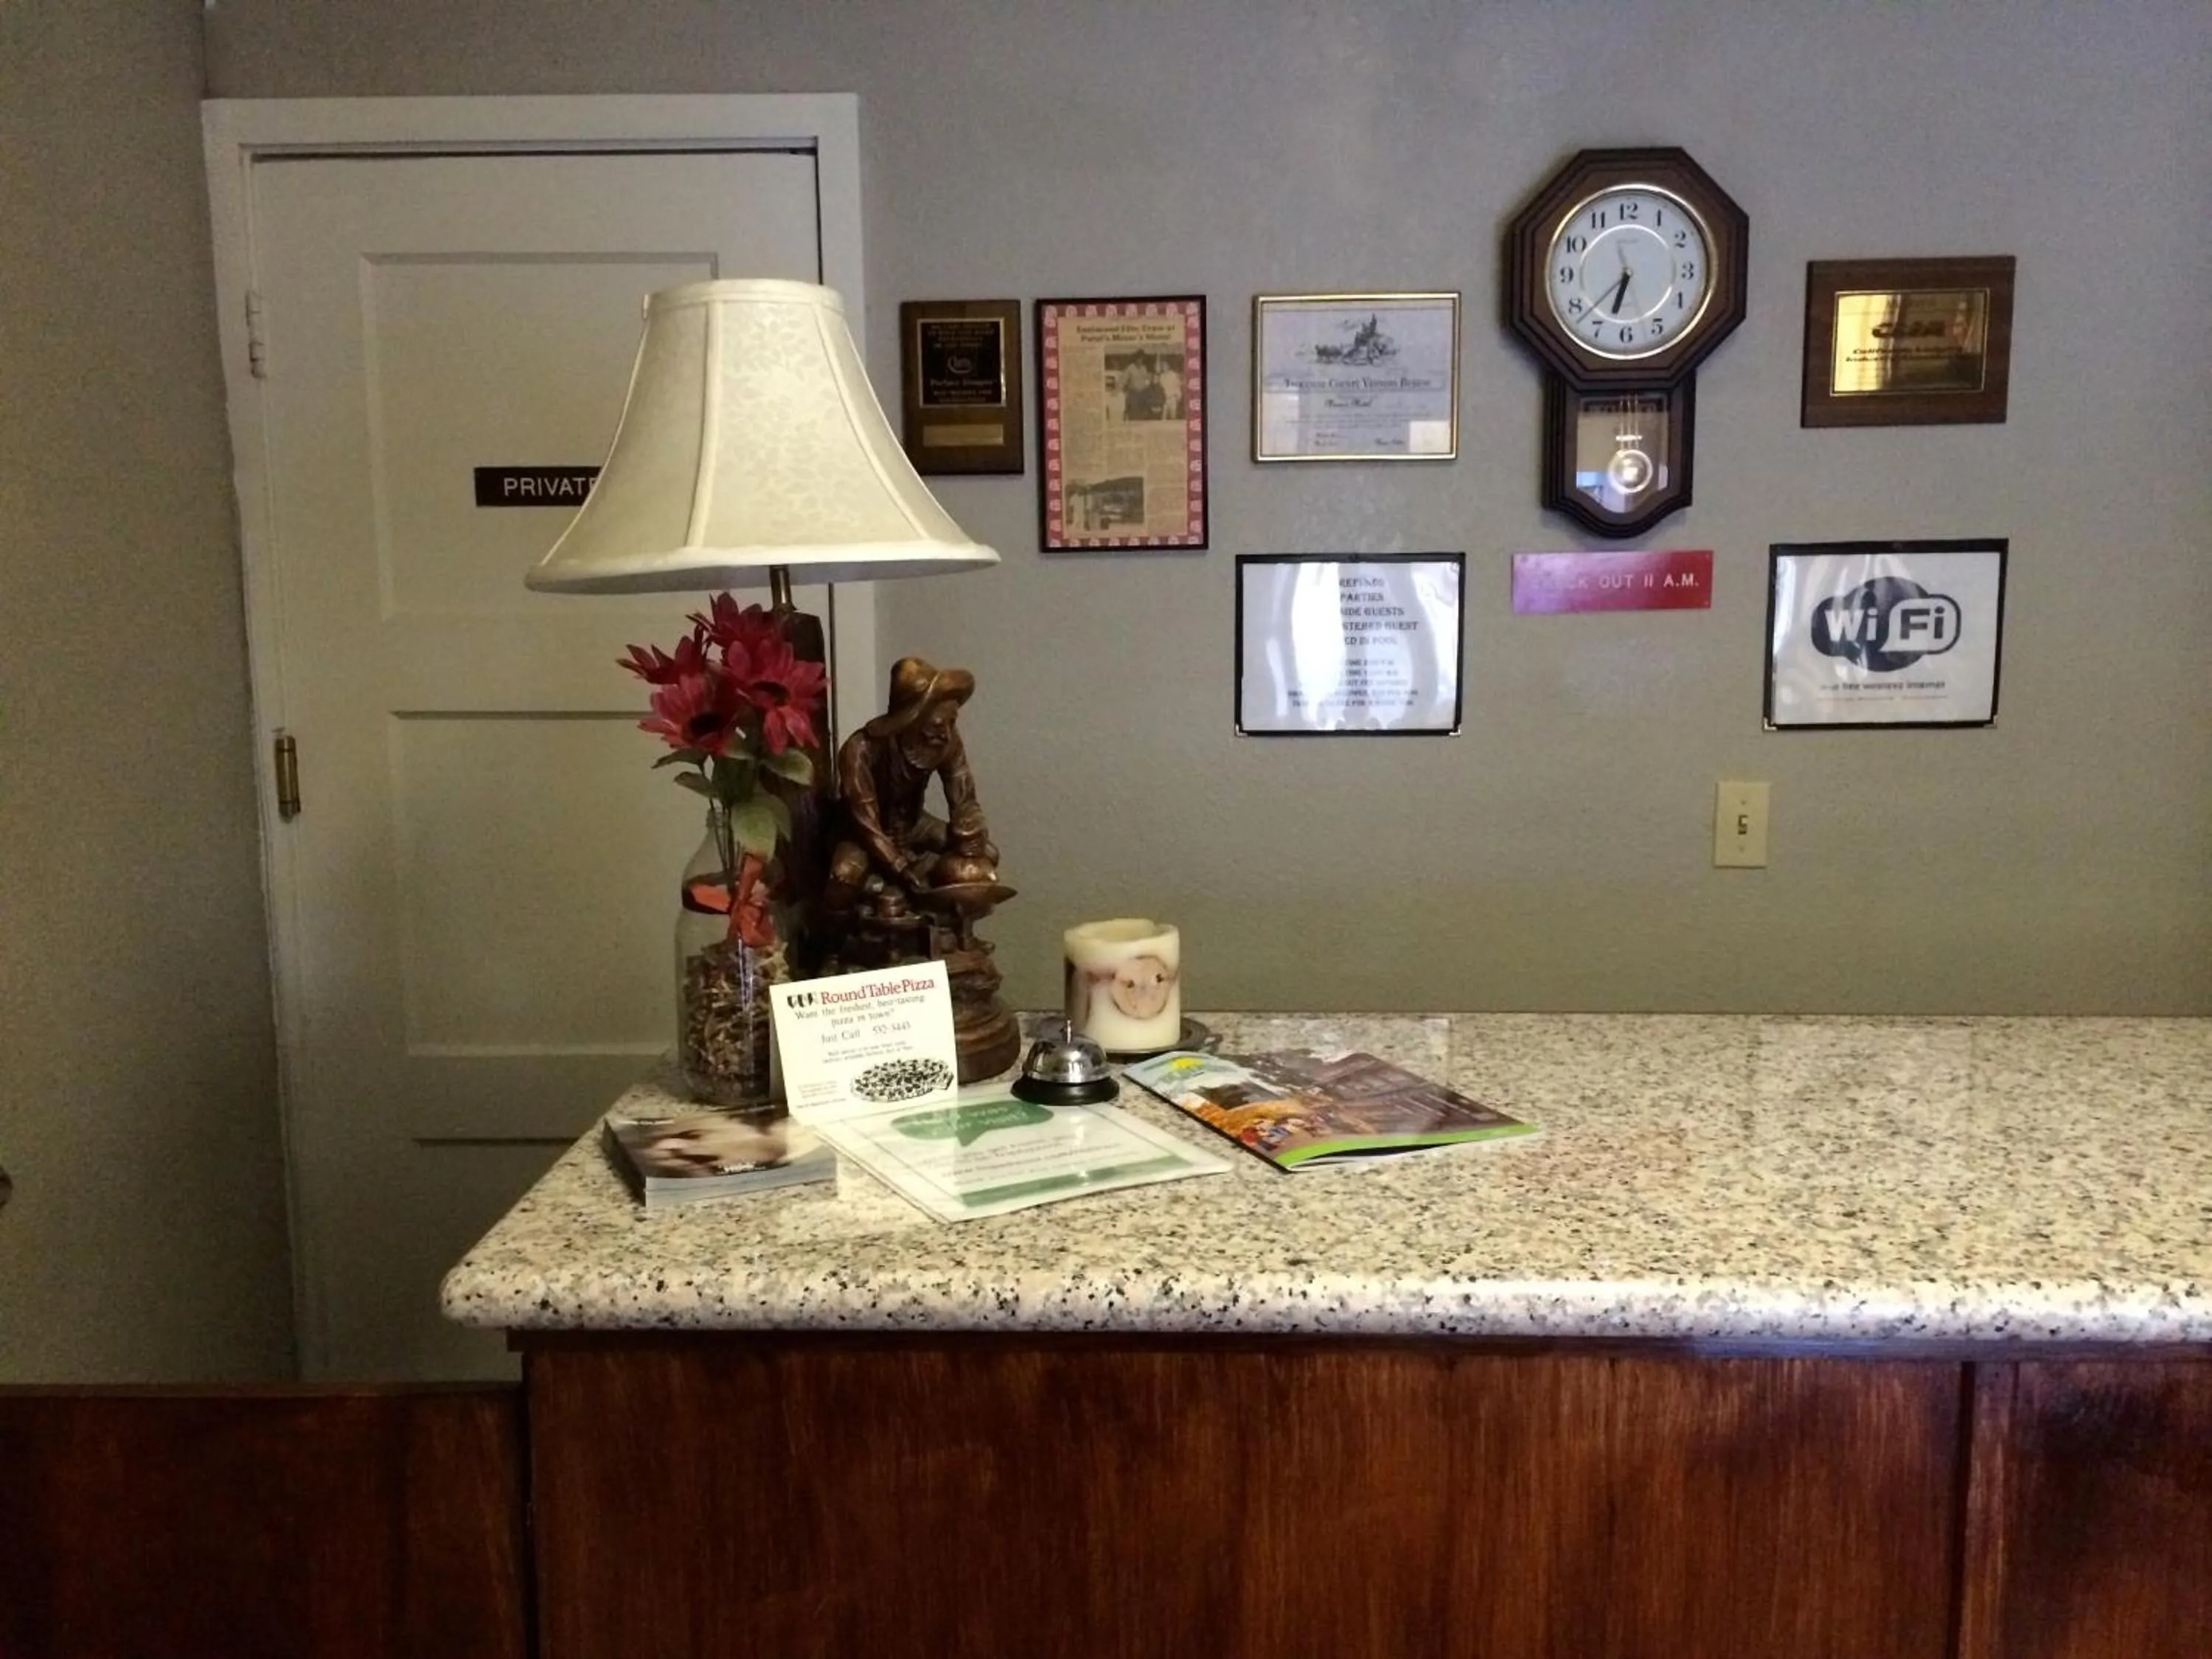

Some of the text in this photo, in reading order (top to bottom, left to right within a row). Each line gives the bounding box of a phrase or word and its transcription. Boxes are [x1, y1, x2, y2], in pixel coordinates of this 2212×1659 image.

[1591, 211, 1606, 229] 11
[1619, 202, 1638, 220] 12
[1656, 209, 1662, 226] 1
[1566, 235, 1587, 253] 10
[1674, 229, 1686, 248] 2
[1559, 265, 1574, 283] 9
[1681, 261, 1694, 279] 3
[1568, 296, 1582, 314] 8
[1591, 320, 1604, 338] 7
[1618, 325, 1633, 343] 6
[1651, 317, 1663, 335] 5
[1599, 574, 1634, 589] OUT
[1663, 573, 1700, 588] A.M.
[1363, 606, 1405, 616] GUESTS
[1384, 621, 1419, 630] GUEST
[1899, 606, 1946, 640] Fi
[821, 978, 935, 1004] Round Table Pizza
[794, 1009, 818, 1020] Want
[821, 1006, 835, 1016] the
[831, 1017, 854, 1029] pizza
[841, 1029, 860, 1040] Call
